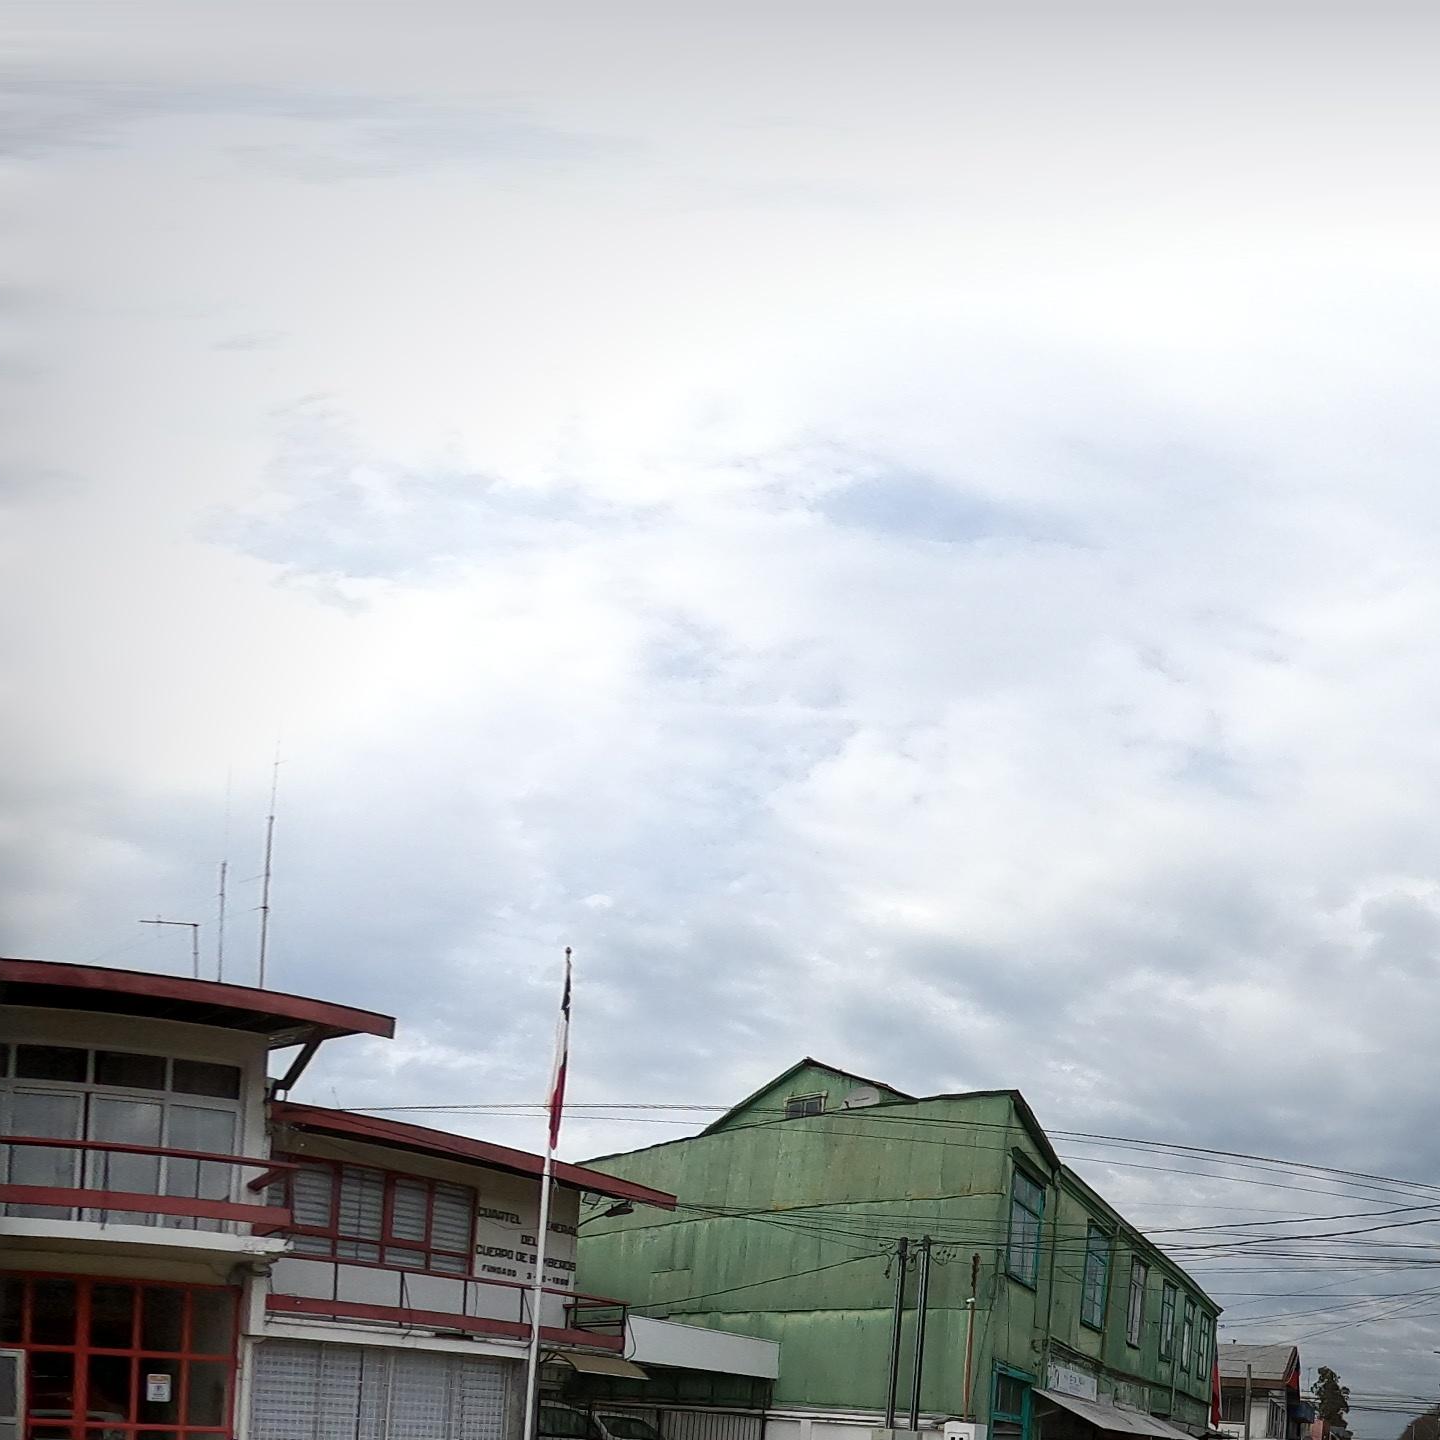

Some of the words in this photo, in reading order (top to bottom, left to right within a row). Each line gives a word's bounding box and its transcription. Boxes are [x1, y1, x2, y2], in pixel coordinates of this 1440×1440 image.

[478, 1206, 522, 1225] CUARTEL
[546, 1220, 579, 1237] ENERAL
[521, 1234, 538, 1247] DEL
[476, 1244, 514, 1260] CUERPO
[516, 1251, 529, 1264] DE
[529, 1254, 576, 1272] BMBEROS
